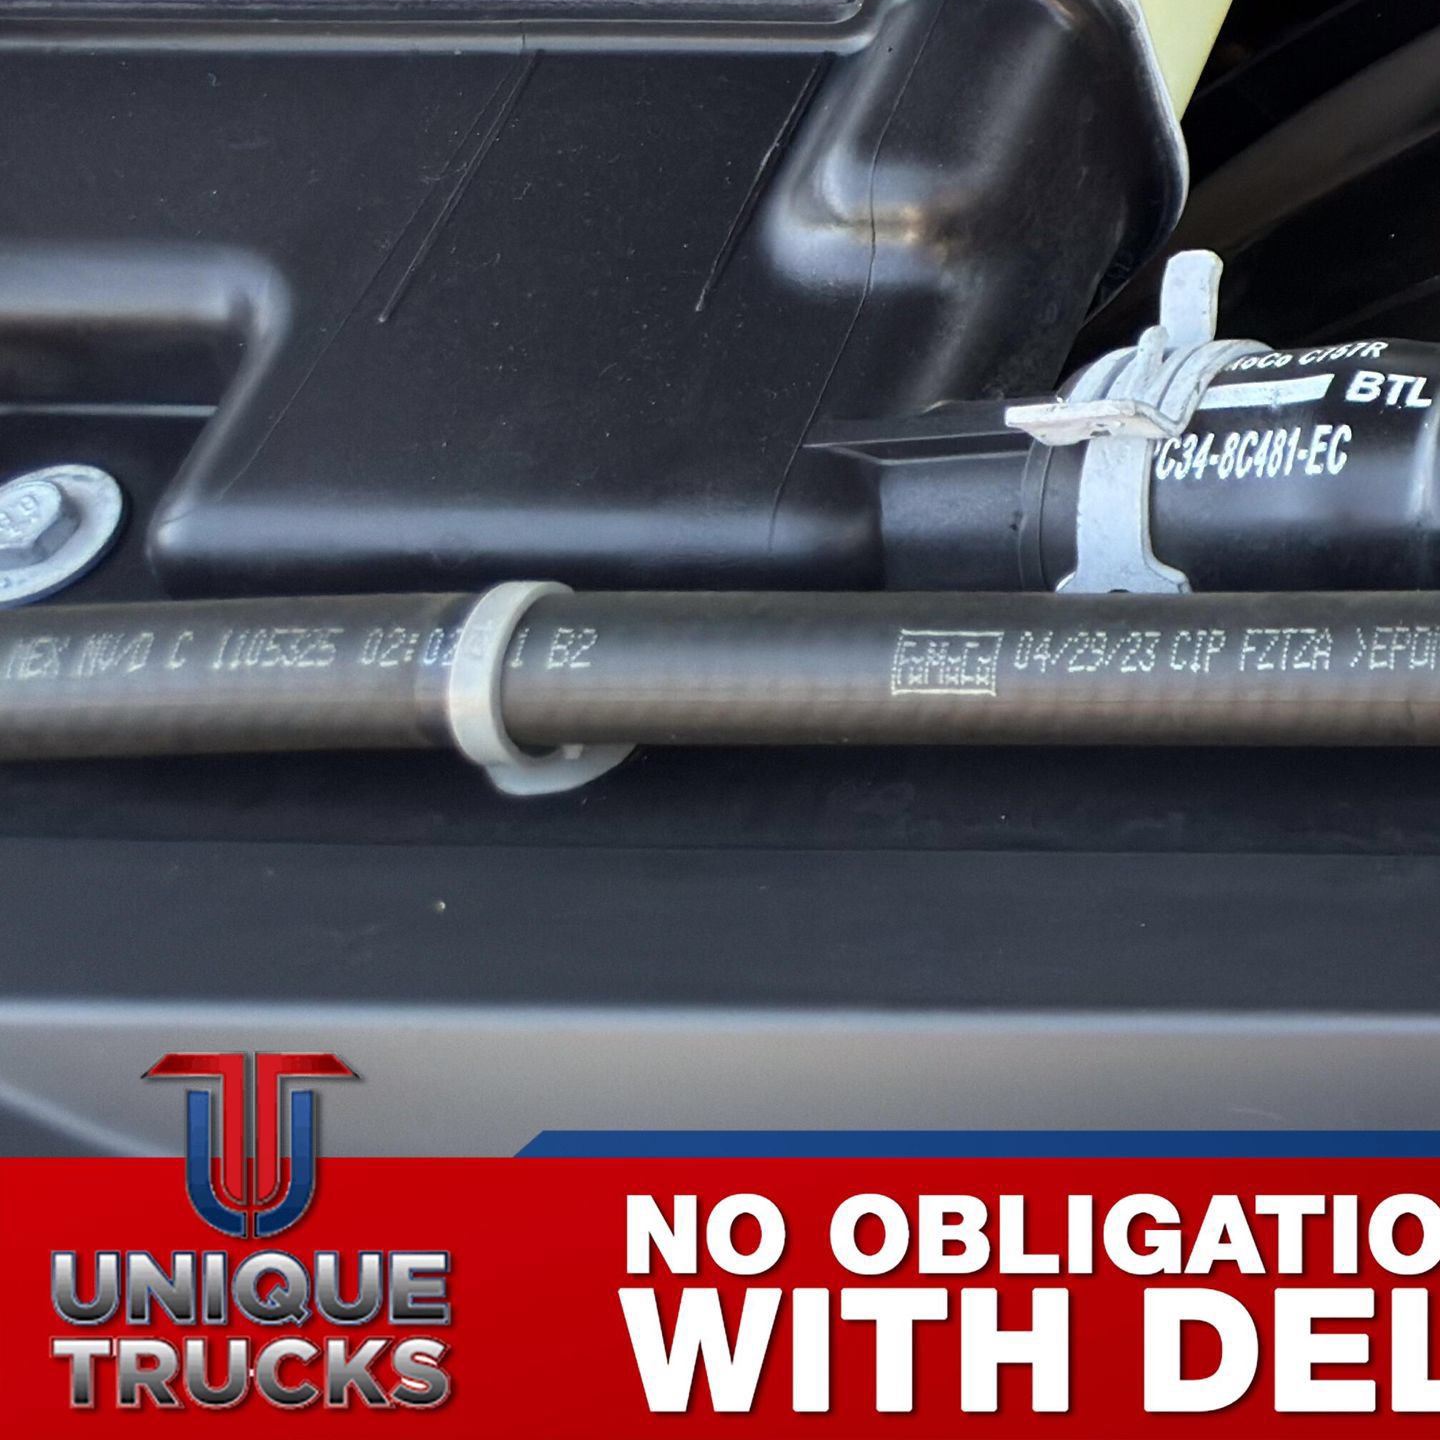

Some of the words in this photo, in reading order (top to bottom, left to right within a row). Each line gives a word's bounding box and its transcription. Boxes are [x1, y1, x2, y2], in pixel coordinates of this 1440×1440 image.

[1345, 370, 1433, 408] BTL
[1154, 423, 1352, 480] C34-8C481-EC
[546, 627, 599, 670] B2
[1012, 630, 1161, 673] 04/29/23
